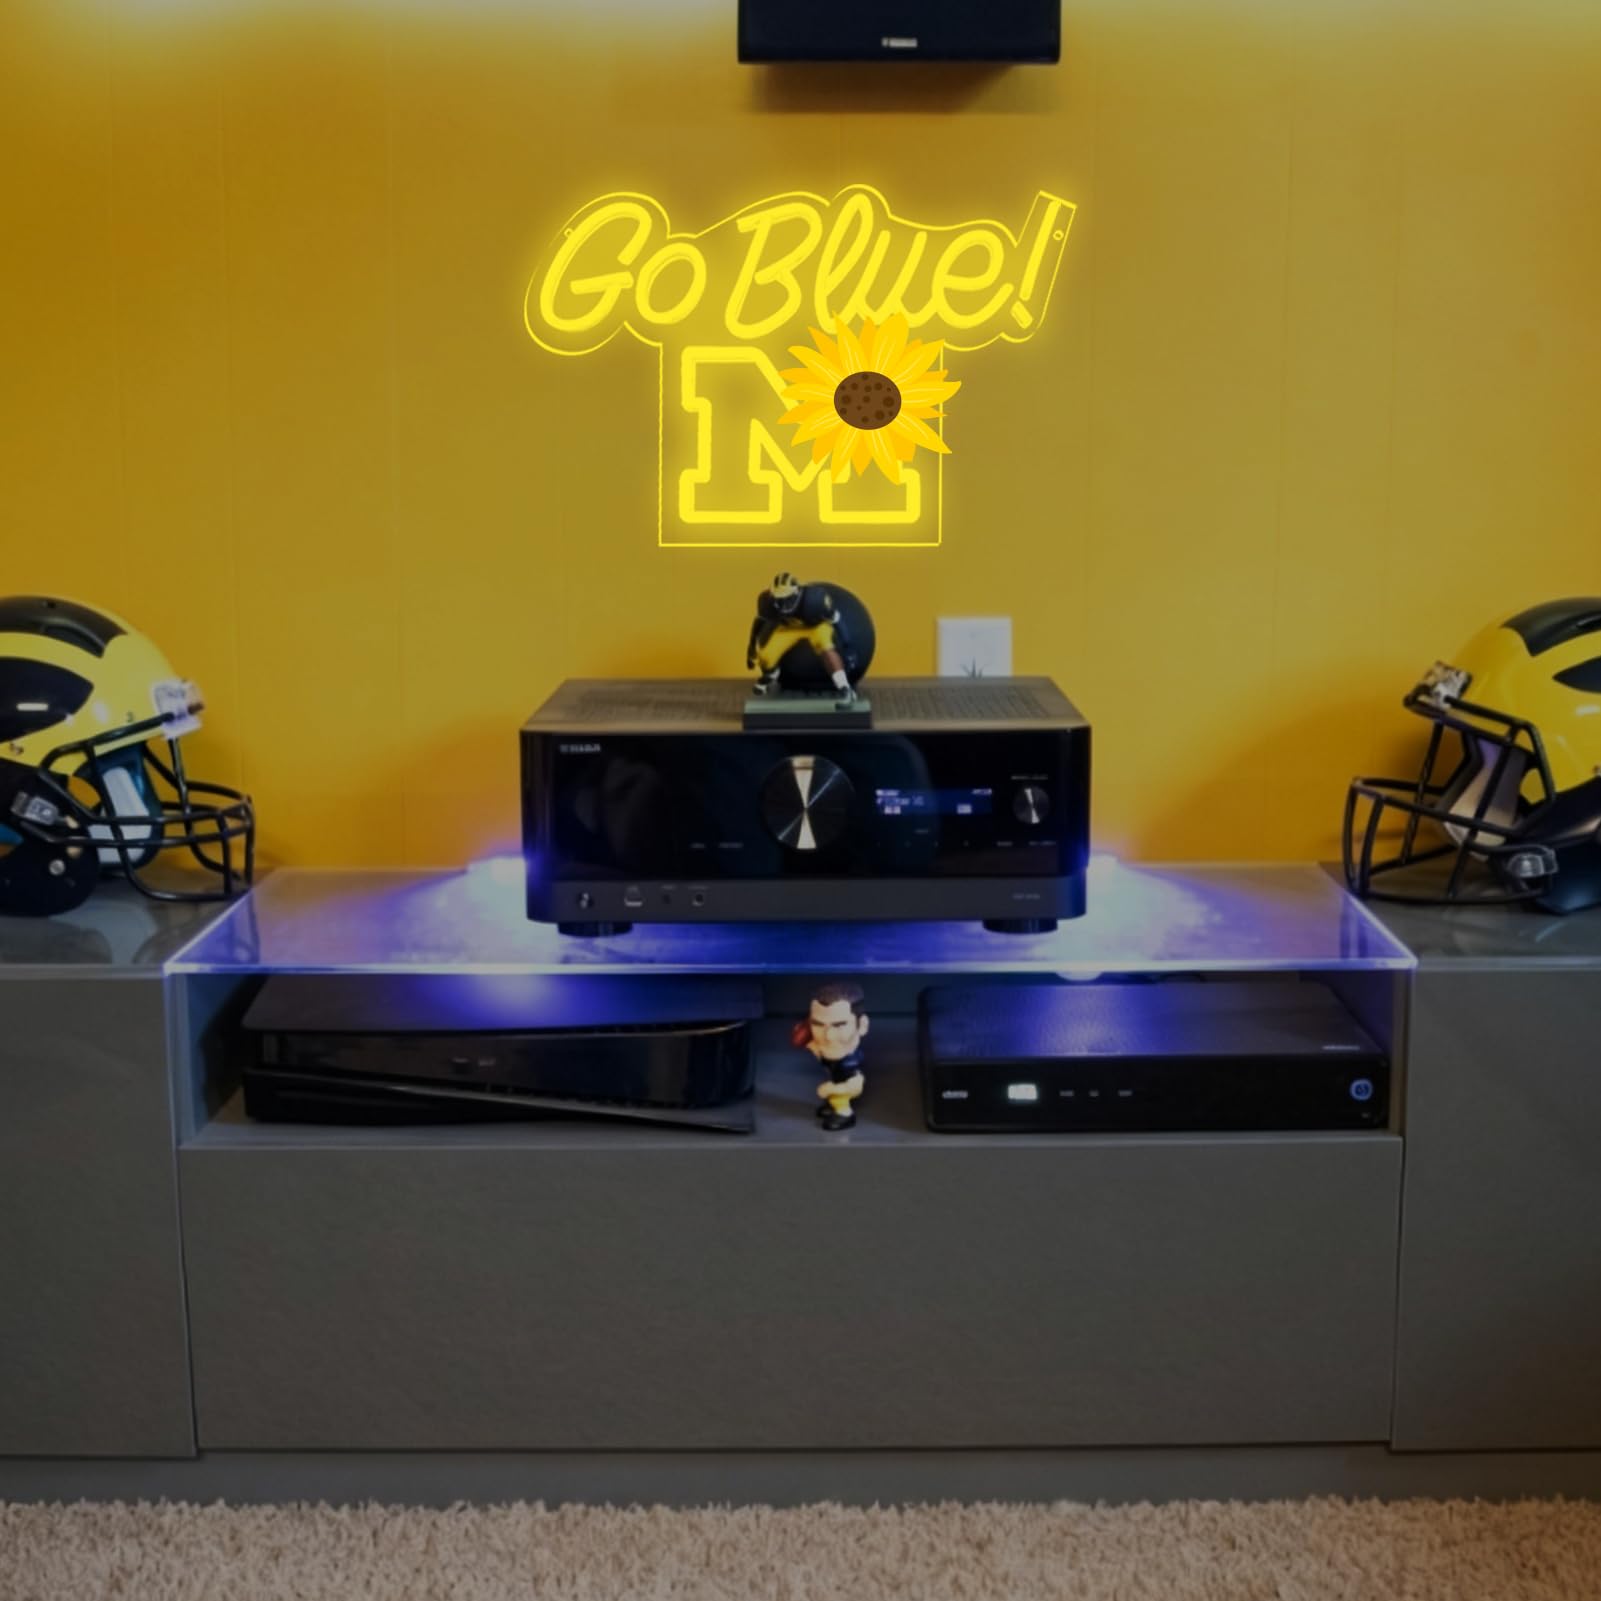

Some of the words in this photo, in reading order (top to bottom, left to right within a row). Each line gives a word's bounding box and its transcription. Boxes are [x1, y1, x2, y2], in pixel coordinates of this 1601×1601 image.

[540, 201, 707, 332] Go
[724, 193, 1062, 339] Blue!
[679, 346, 921, 524] M
